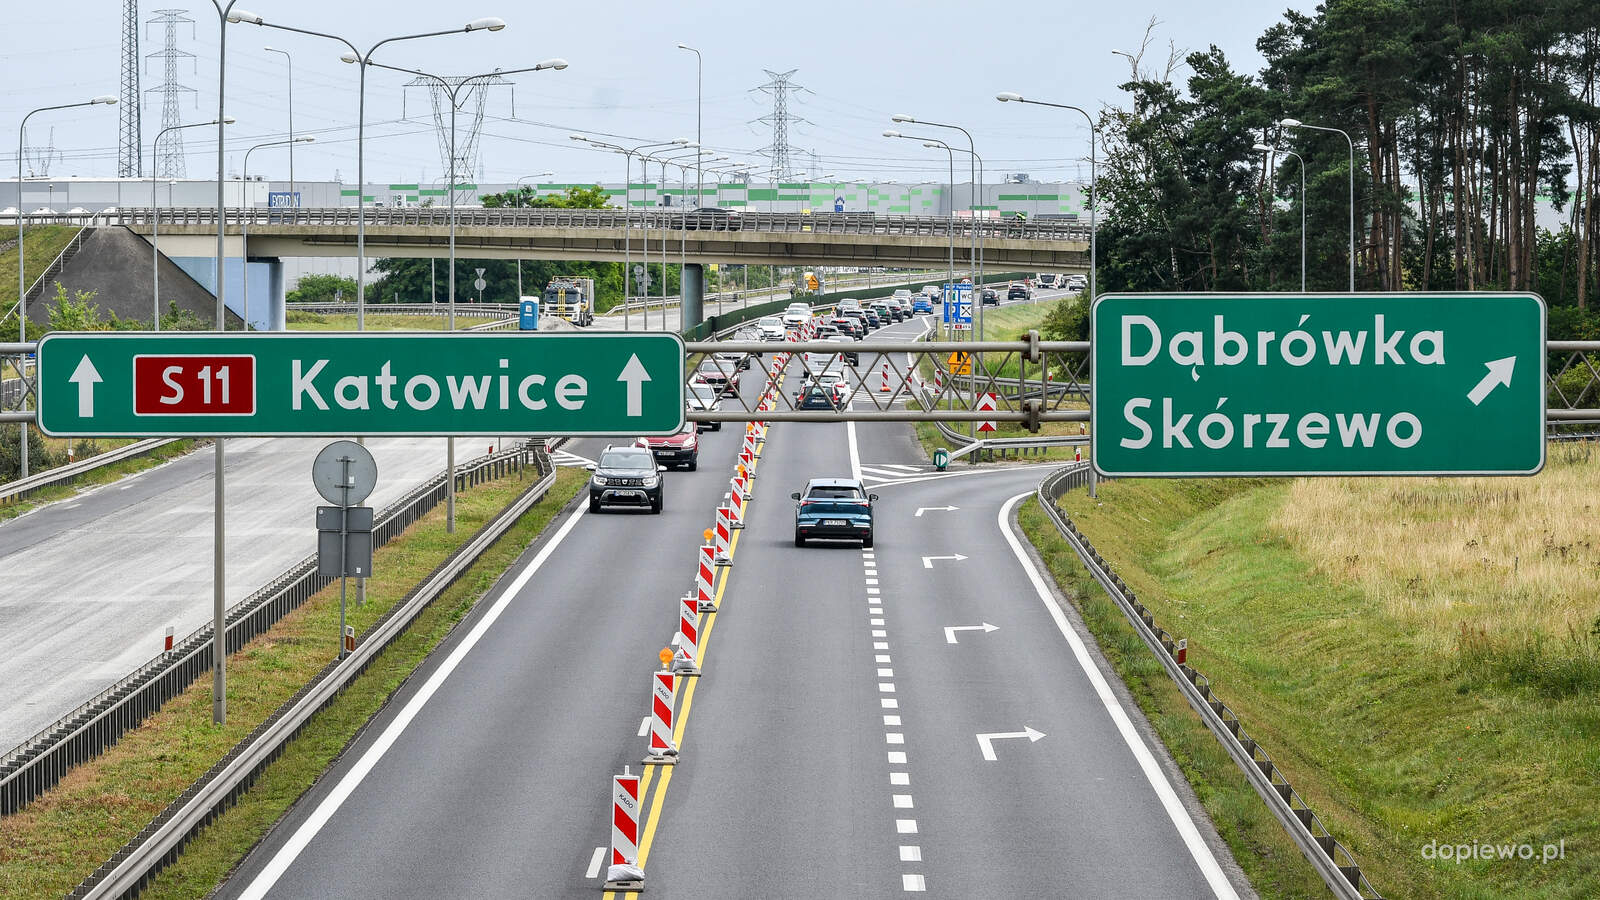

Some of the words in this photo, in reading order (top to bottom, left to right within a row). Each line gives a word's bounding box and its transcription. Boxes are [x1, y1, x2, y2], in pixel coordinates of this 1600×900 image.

[1121, 314, 1446, 382] Dąbrówka
[159, 365, 184, 405] S
[197, 365, 230, 405] 11
[292, 358, 588, 411] Katowice
[1119, 397, 1422, 449] Skórzewo
[619, 793, 634, 809] KADO
